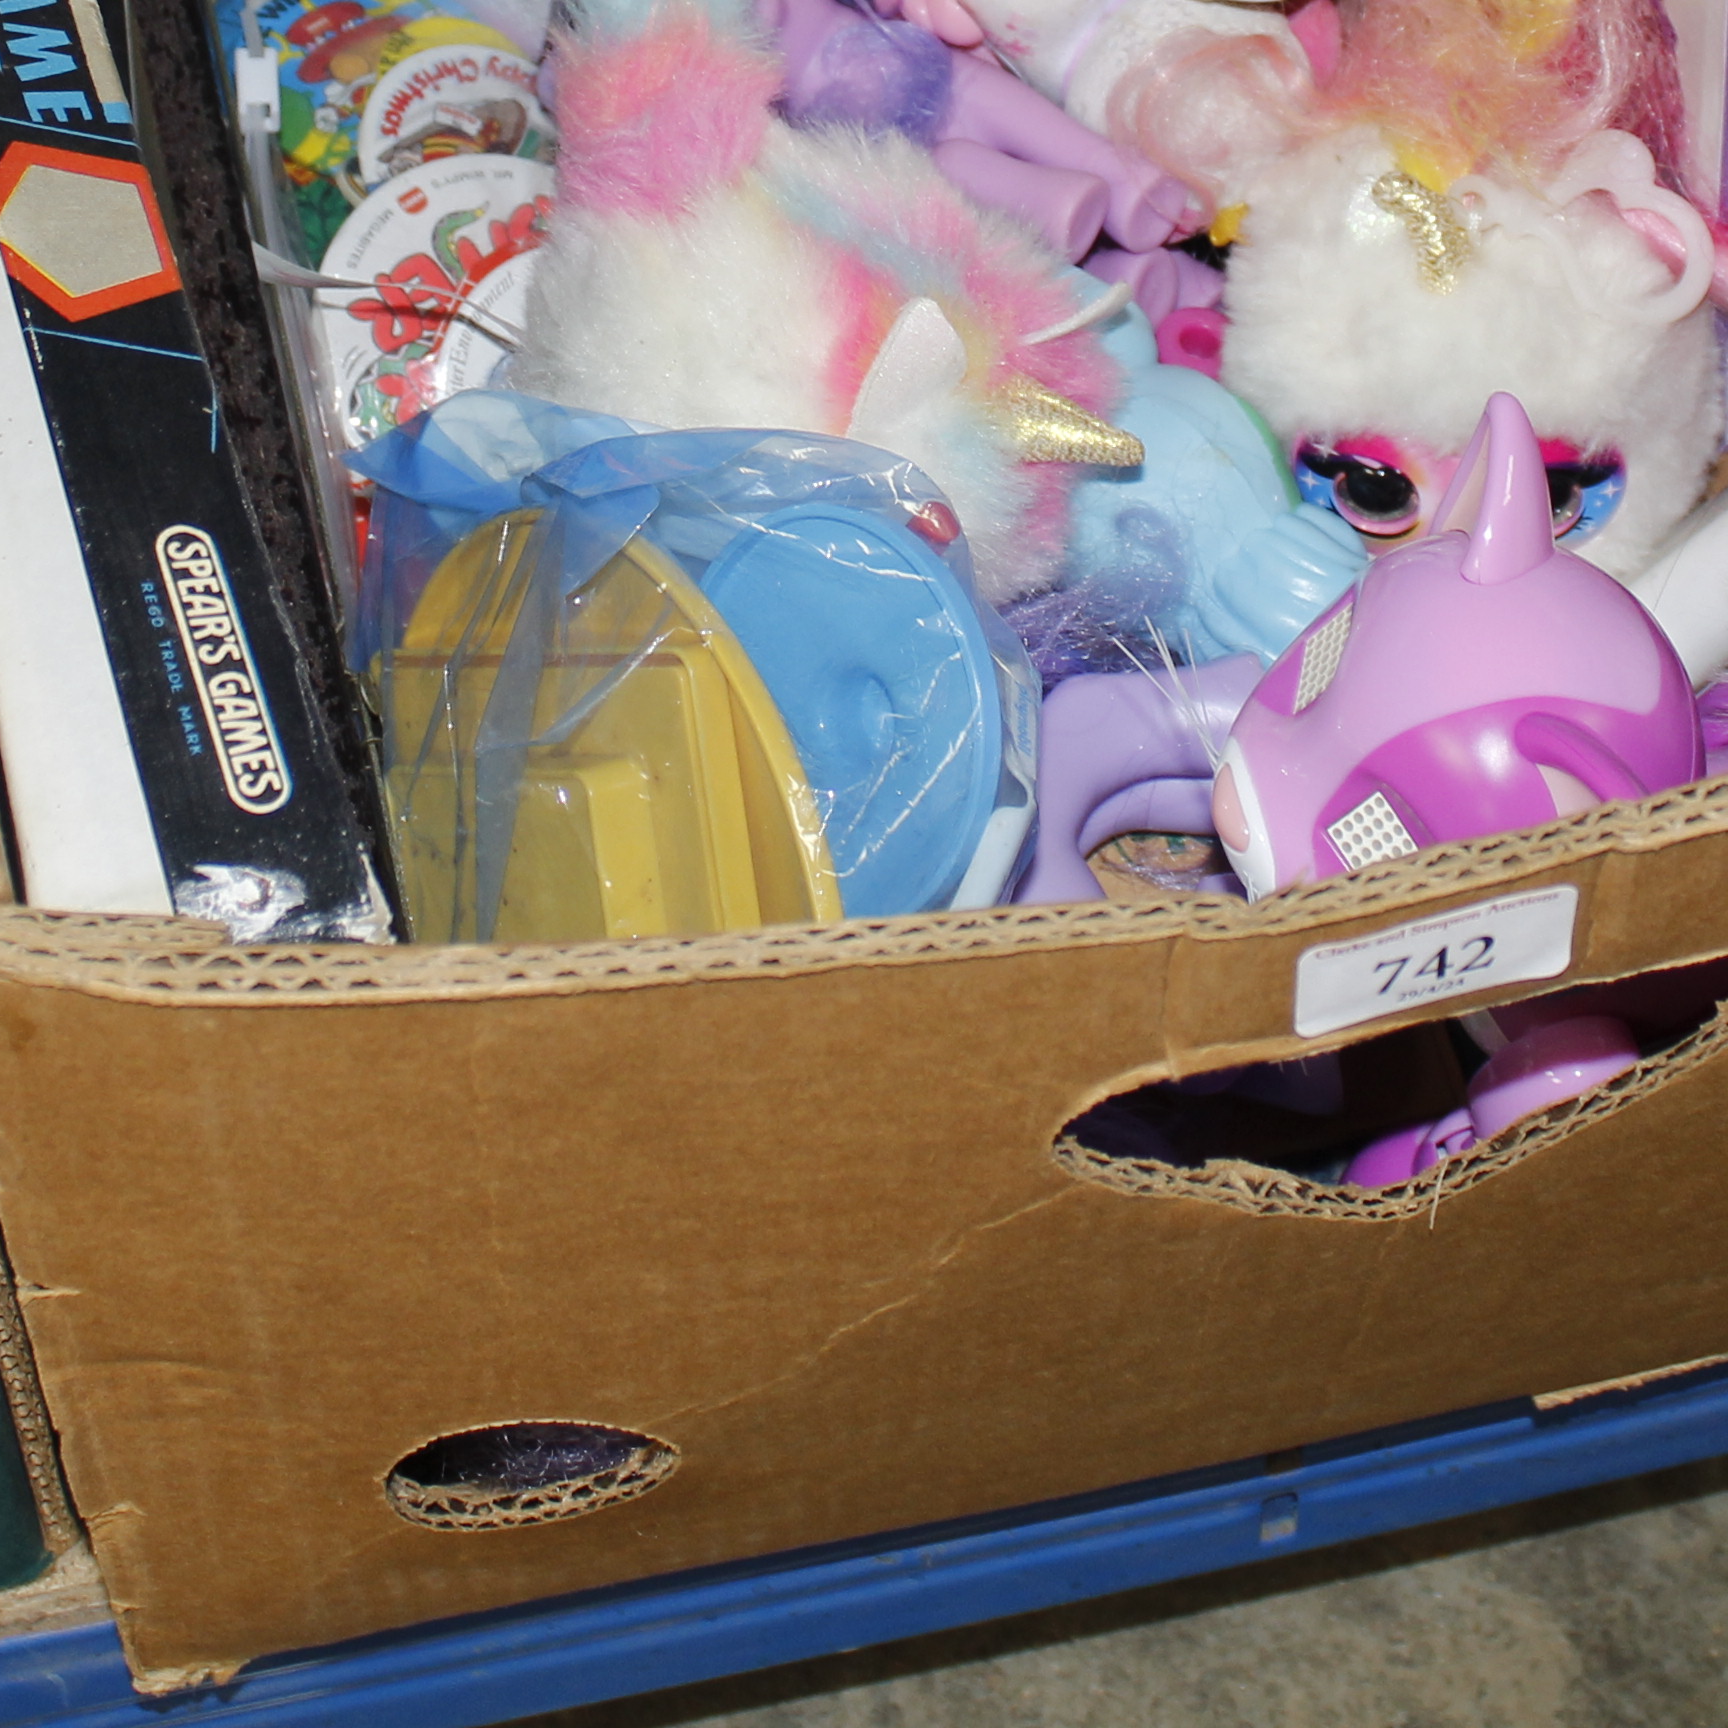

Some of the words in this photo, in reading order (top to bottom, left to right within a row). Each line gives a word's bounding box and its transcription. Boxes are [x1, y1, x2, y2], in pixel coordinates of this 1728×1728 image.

[380, 58, 481, 139] Christmas
[347, 206, 396, 273] MEGABITES
[156, 638, 187, 694] TRADE
[175, 703, 205, 757] MARK
[163, 531, 242, 671] SPEAR'S
[204, 665, 282, 802] GAMES
[1408, 908, 1482, 938] Simpson
[1489, 889, 1561, 916] Auctions
[1373, 934, 1497, 997] 742
[1398, 977, 1466, 1003] 29/4/24
